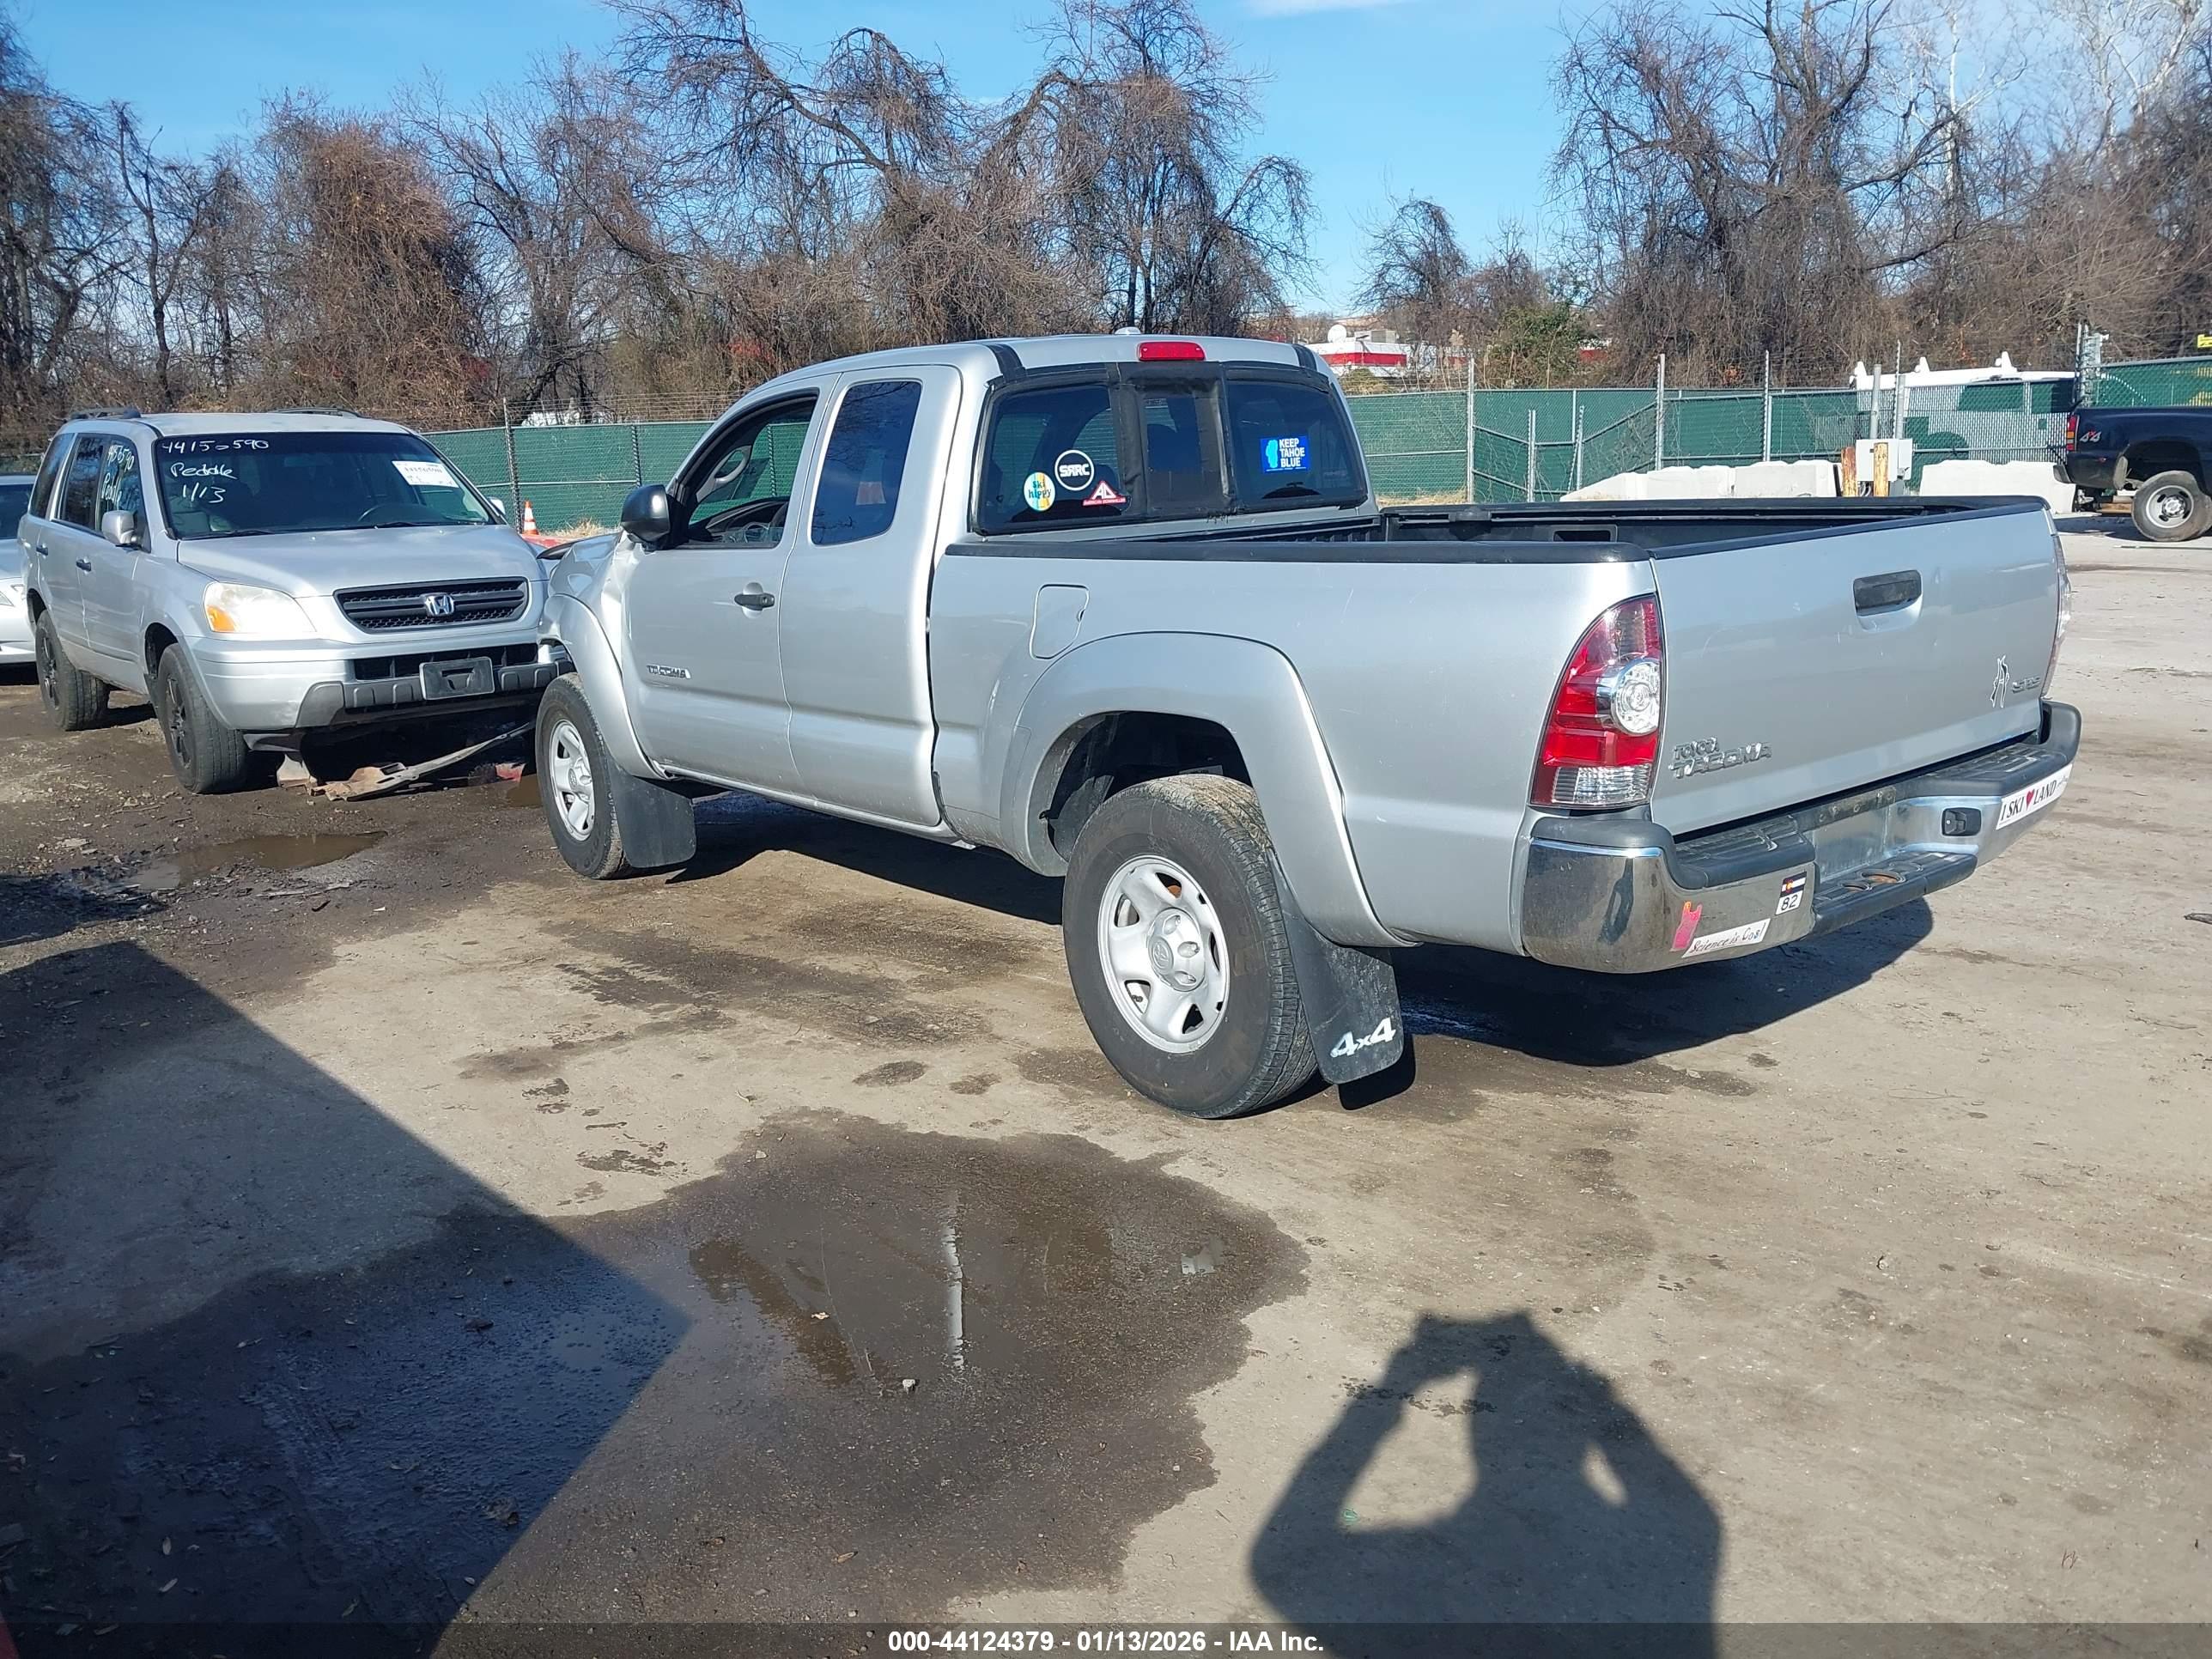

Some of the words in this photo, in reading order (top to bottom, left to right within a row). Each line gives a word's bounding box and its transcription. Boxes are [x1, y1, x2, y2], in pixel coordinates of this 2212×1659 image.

[1279, 438, 1299, 448] KEEP
[1279, 447, 1305, 458] TAHOE
[1280, 457, 1301, 468] BLUE
[182, 482, 227, 503] 1/13
[1668, 742, 1772, 779] TACOMA
[2006, 796, 2025, 818] SKI
[2033, 780, 2057, 805] LAND
[1781, 894, 1798, 912] 82
[1689, 937, 1729, 954] Science
[1729, 932, 1740, 945] is
[1330, 1017, 1396, 1058] 4x4
